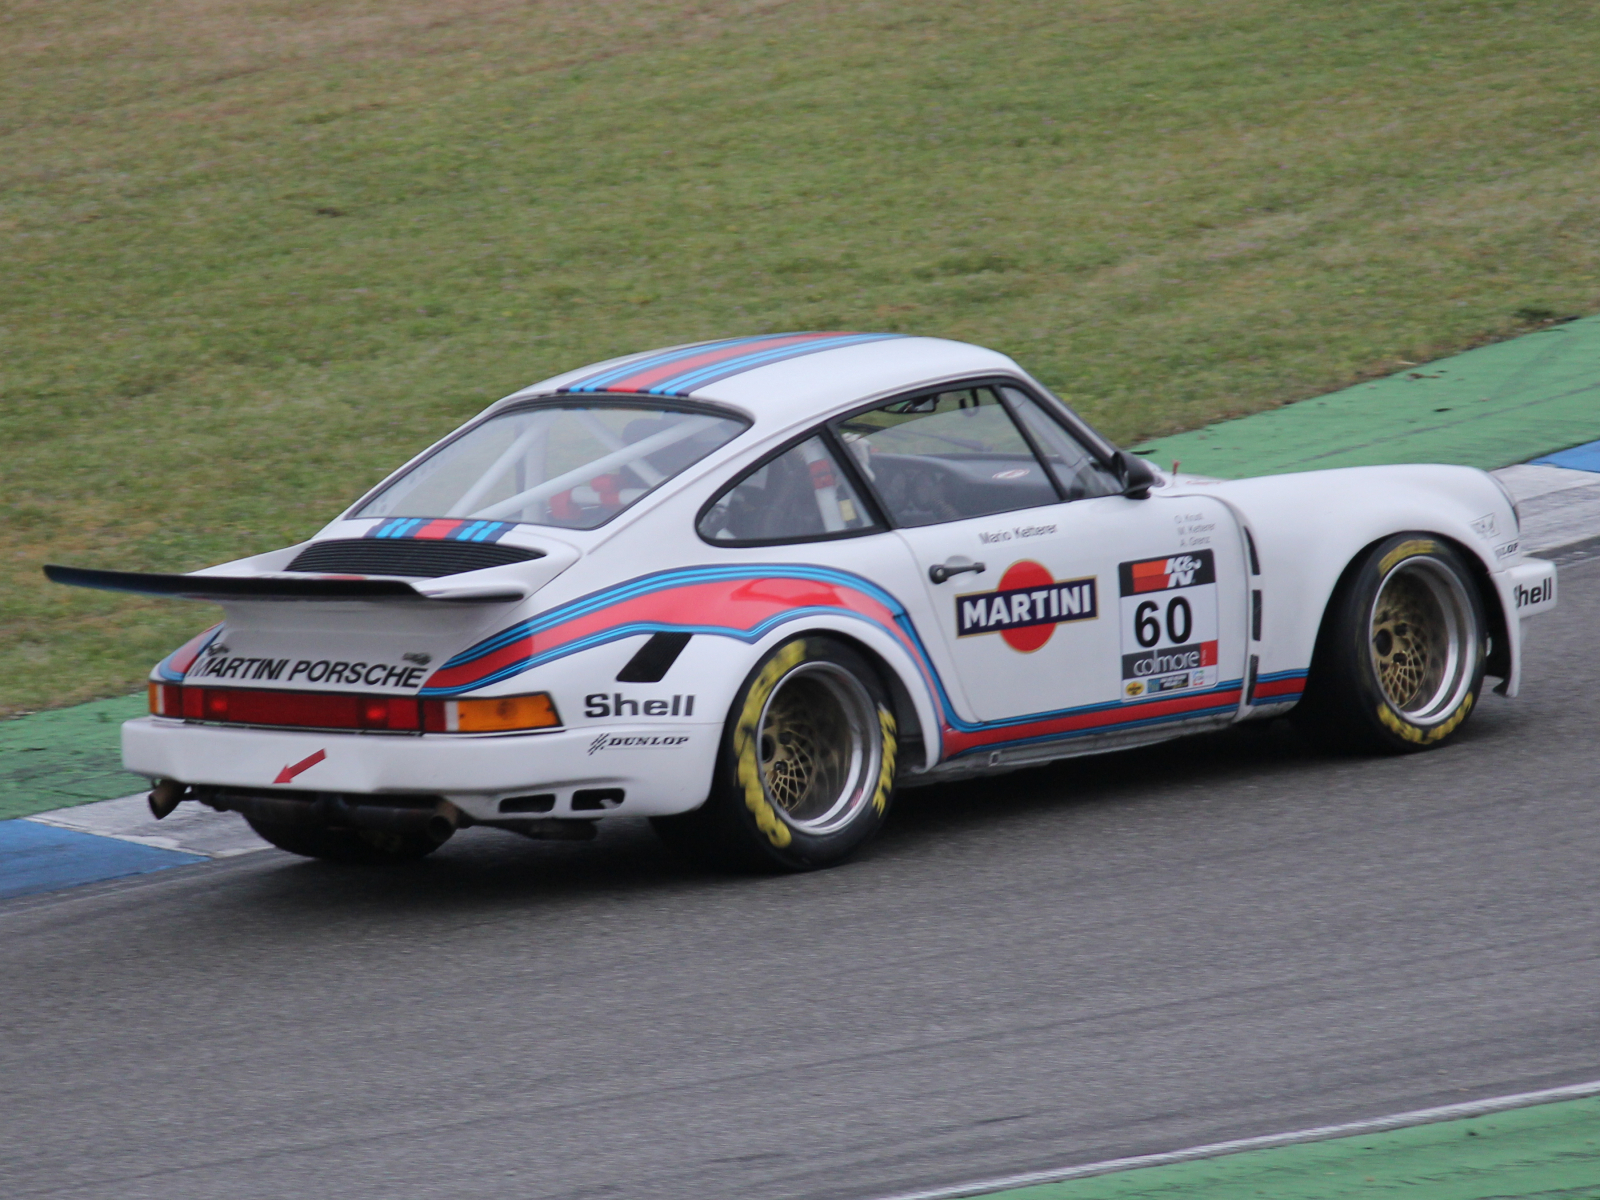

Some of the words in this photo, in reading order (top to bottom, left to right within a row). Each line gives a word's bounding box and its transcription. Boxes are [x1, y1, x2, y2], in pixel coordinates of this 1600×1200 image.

[979, 530, 1011, 545] Mario
[1013, 524, 1057, 539] Ketterer
[963, 584, 1092, 629] MARTINI
[1134, 596, 1193, 648] 60
[187, 657, 291, 681] MARTINI
[288, 660, 431, 689] PORSCHE
[1133, 649, 1200, 676] colmore
[585, 693, 695, 718] Shell
[607, 737, 690, 747] DUNLOP
